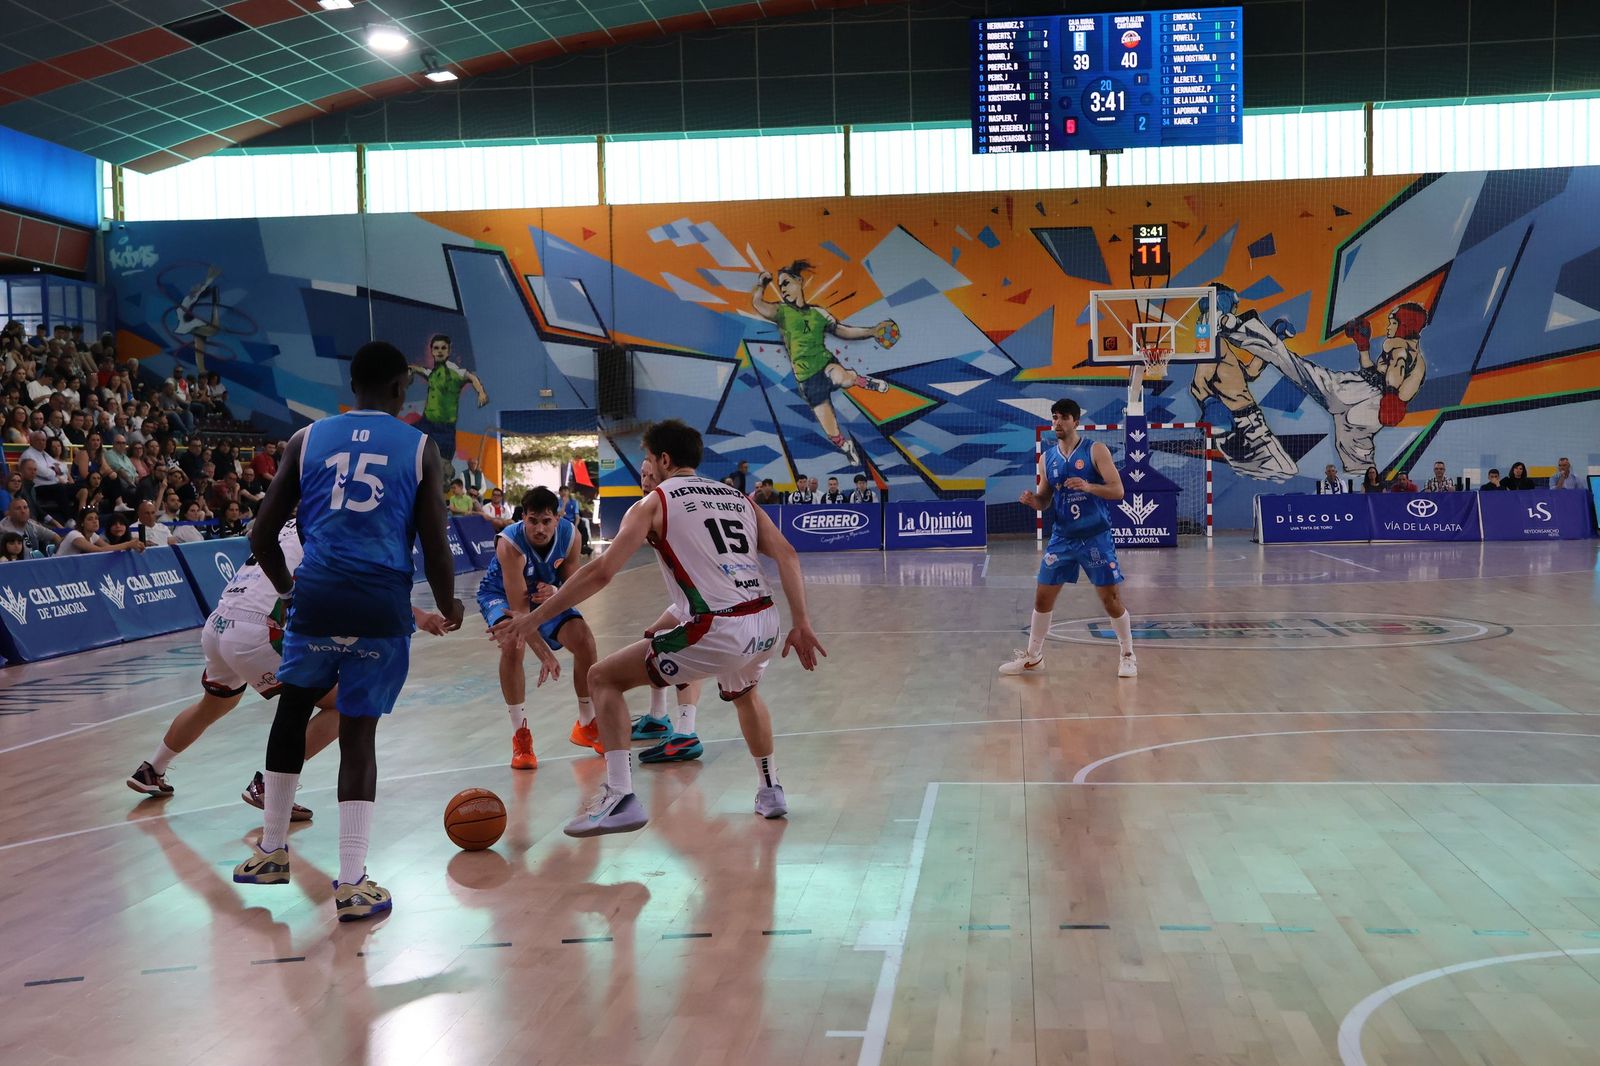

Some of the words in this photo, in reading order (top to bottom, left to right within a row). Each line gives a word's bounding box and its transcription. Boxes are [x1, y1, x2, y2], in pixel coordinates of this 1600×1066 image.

[1073, 54, 1090, 70] 39
[1121, 52, 1138, 68] 40
[1090, 90, 1124, 112] 3:41
[1139, 116, 1146, 130] 2
[1026, 134, 1032, 142] S
[1045, 133, 1050, 141] 3
[1140, 226, 1162, 236] 3:41
[1138, 244, 1160, 264] 11
[352, 429, 370, 442] LO
[325, 452, 388, 512] 15
[1070, 504, 1080, 520] 9
[802, 514, 860, 528] FERRERO
[898, 512, 915, 530] La
[920, 510, 972, 534] Opinión
[1384, 521, 1400, 530] VÍA
[1403, 522, 1416, 530] DE
[1434, 524, 1462, 532] PLATA
[704, 518, 749, 554] 15
[1110, 528, 1133, 536] CAJA
[1135, 528, 1170, 536] RURAL
[126, 575, 150, 592] CAJA
[151, 569, 184, 587] RURAL
[28, 587, 56, 605] CAJA
[56, 580, 96, 602] RURAL
[134, 594, 146, 606] DE
[146, 588, 176, 604] ZAMORA
[37, 608, 50, 620] DE
[51, 602, 88, 618] ZAMORA
[662, 662, 675, 674] B
